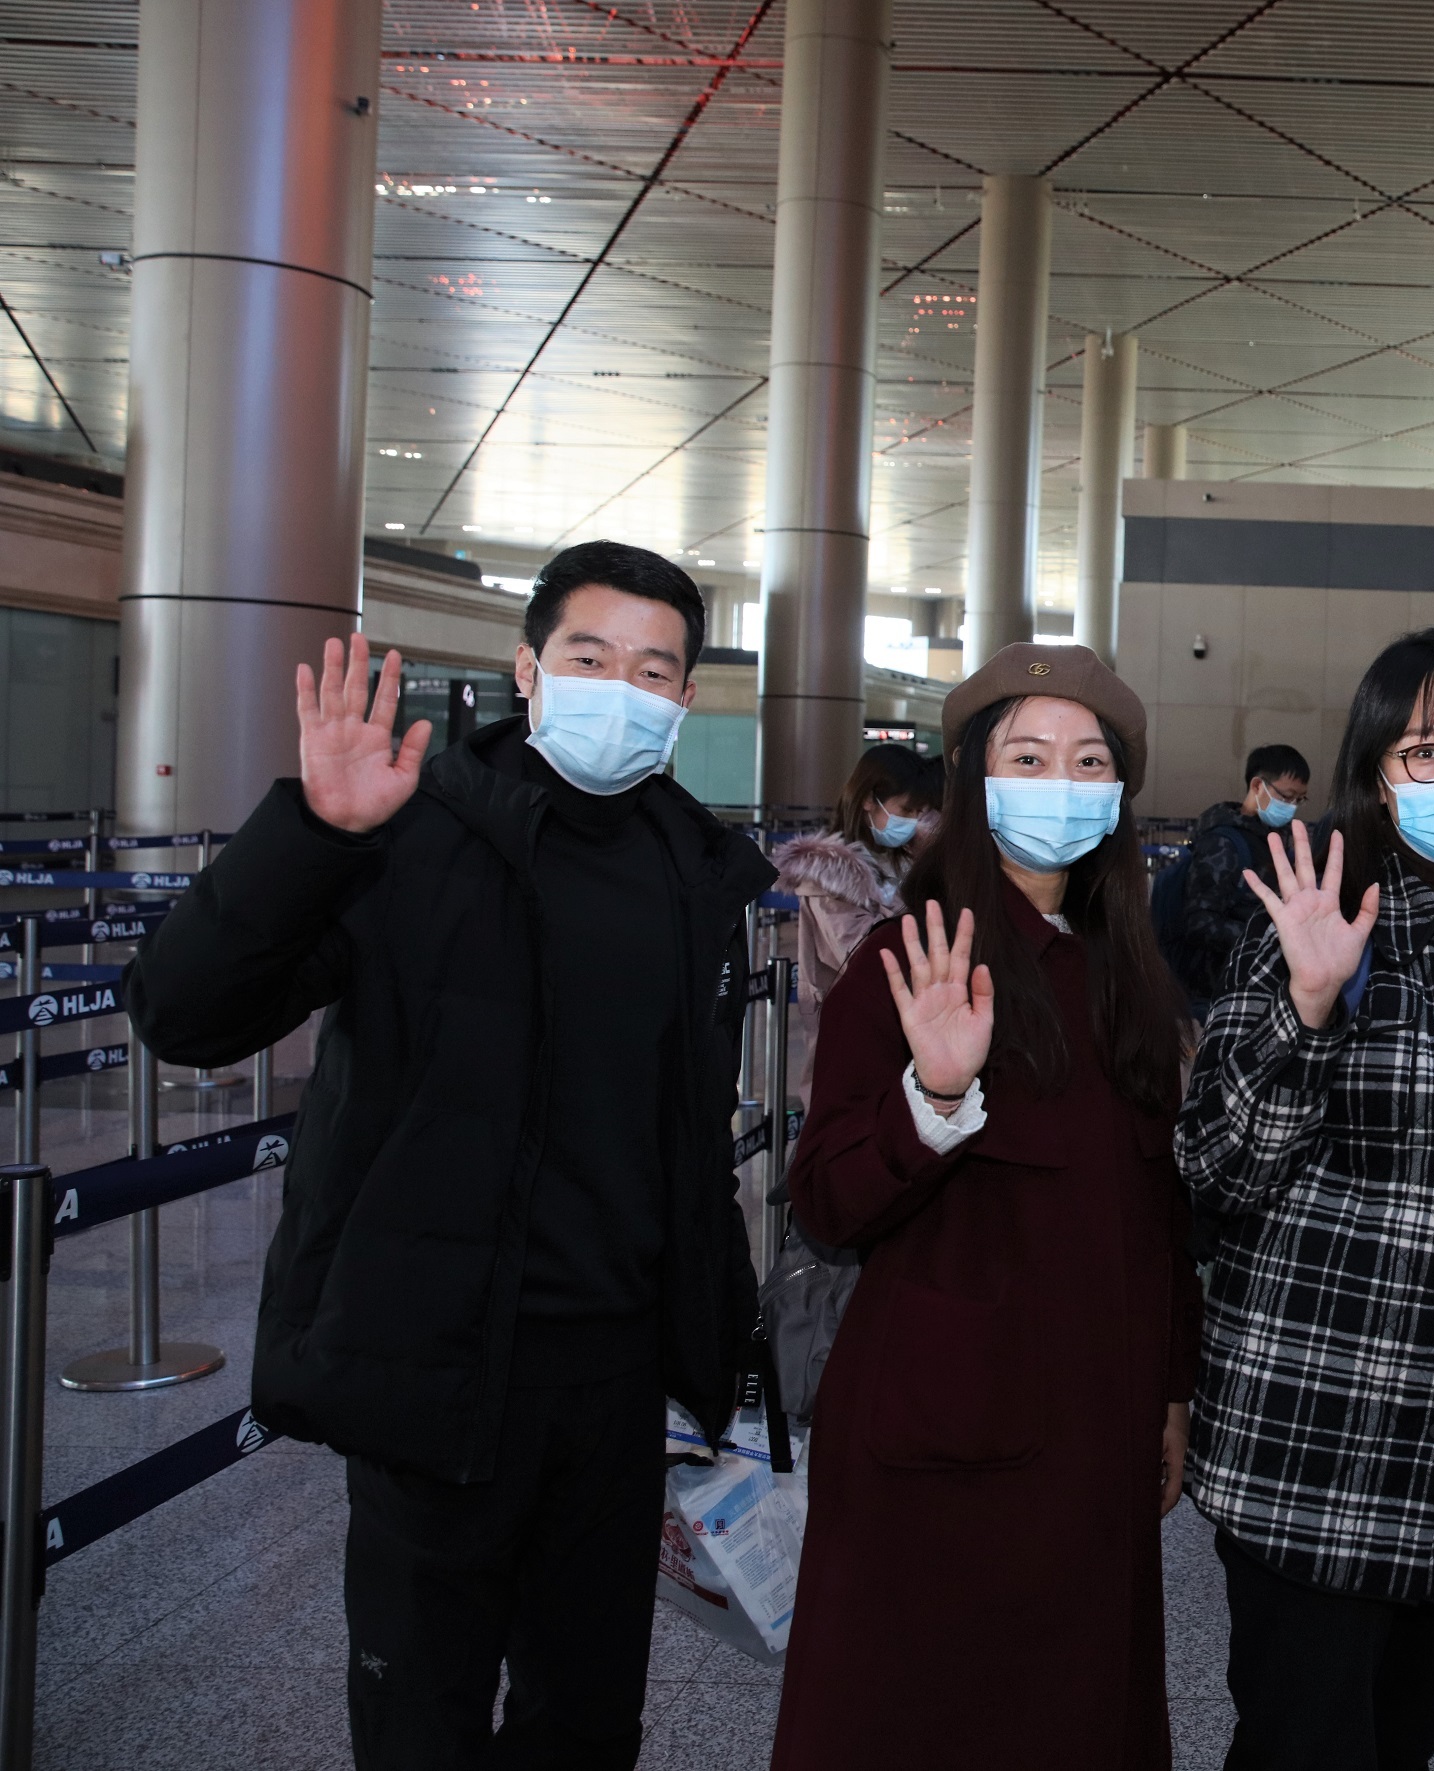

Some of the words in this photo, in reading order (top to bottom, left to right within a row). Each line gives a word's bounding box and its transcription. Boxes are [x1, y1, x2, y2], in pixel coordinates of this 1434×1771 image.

[60, 839, 84, 849] HLJA
[16, 873, 54, 885] HLJA
[153, 875, 191, 887] HLJA
[111, 921, 146, 937] HLJA
[63, 989, 116, 1017] HLJA
[744, 1373, 760, 1404] ELLE
